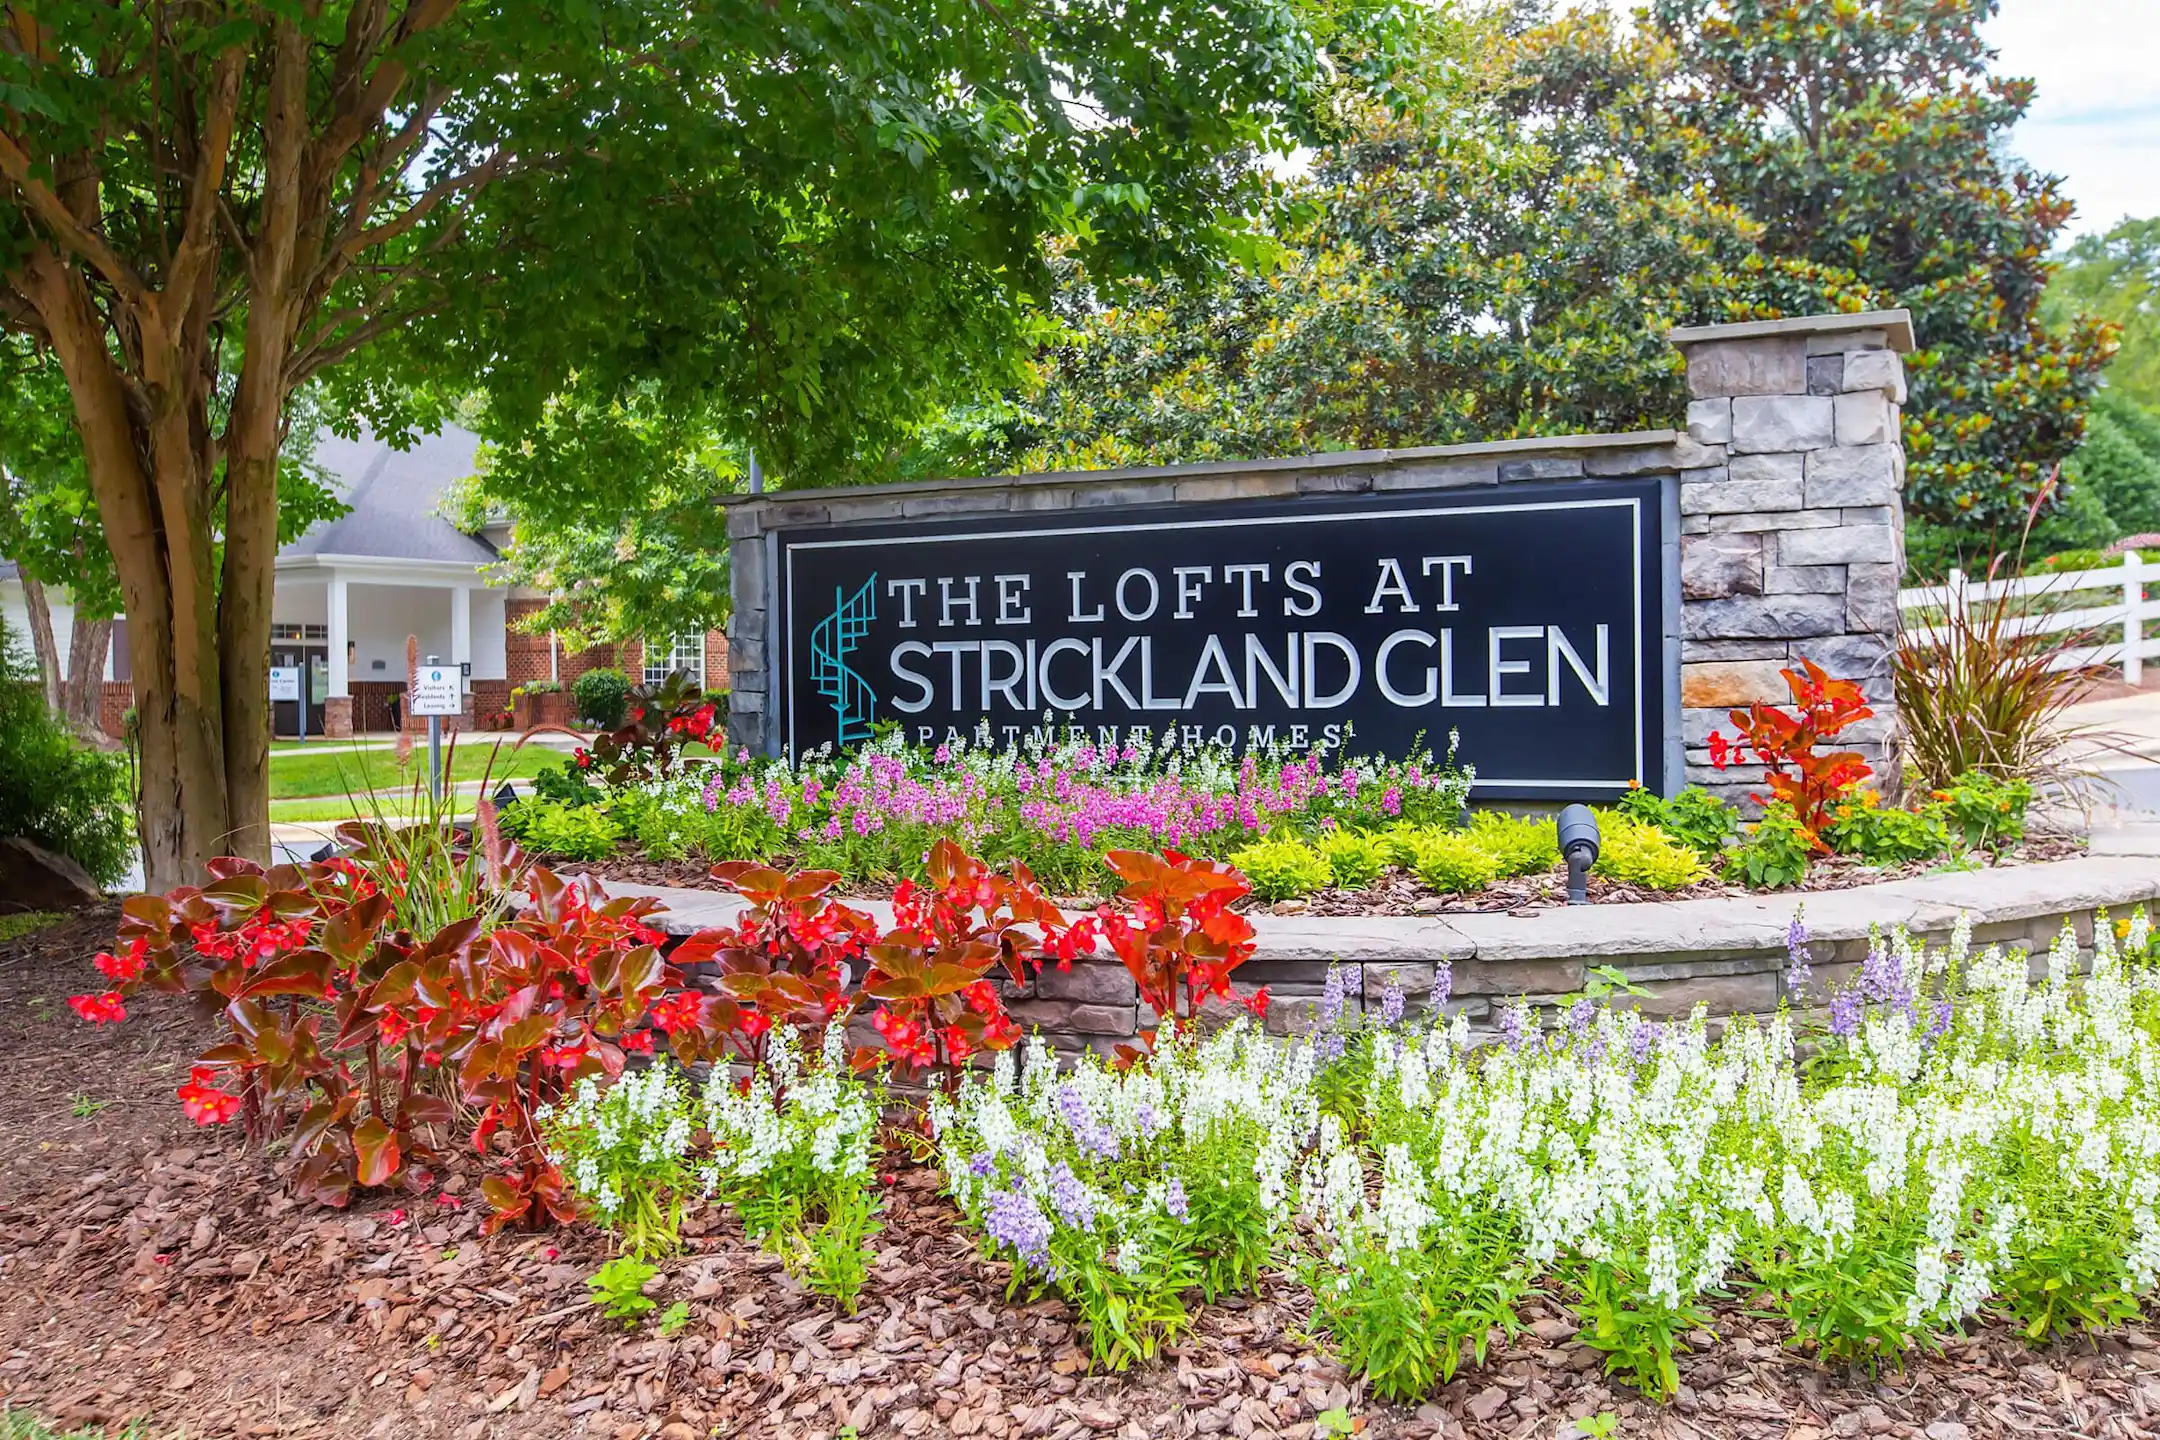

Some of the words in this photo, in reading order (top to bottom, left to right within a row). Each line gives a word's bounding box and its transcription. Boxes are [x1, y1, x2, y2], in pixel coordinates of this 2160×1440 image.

[888, 574, 1031, 628] THE
[1067, 560, 1323, 622] LOFTS
[1364, 555, 1472, 614] AT
[890, 631, 1361, 714] STRICKLAND
[1375, 623, 1609, 708] GLEN
[1181, 724, 1342, 749] HOMES
